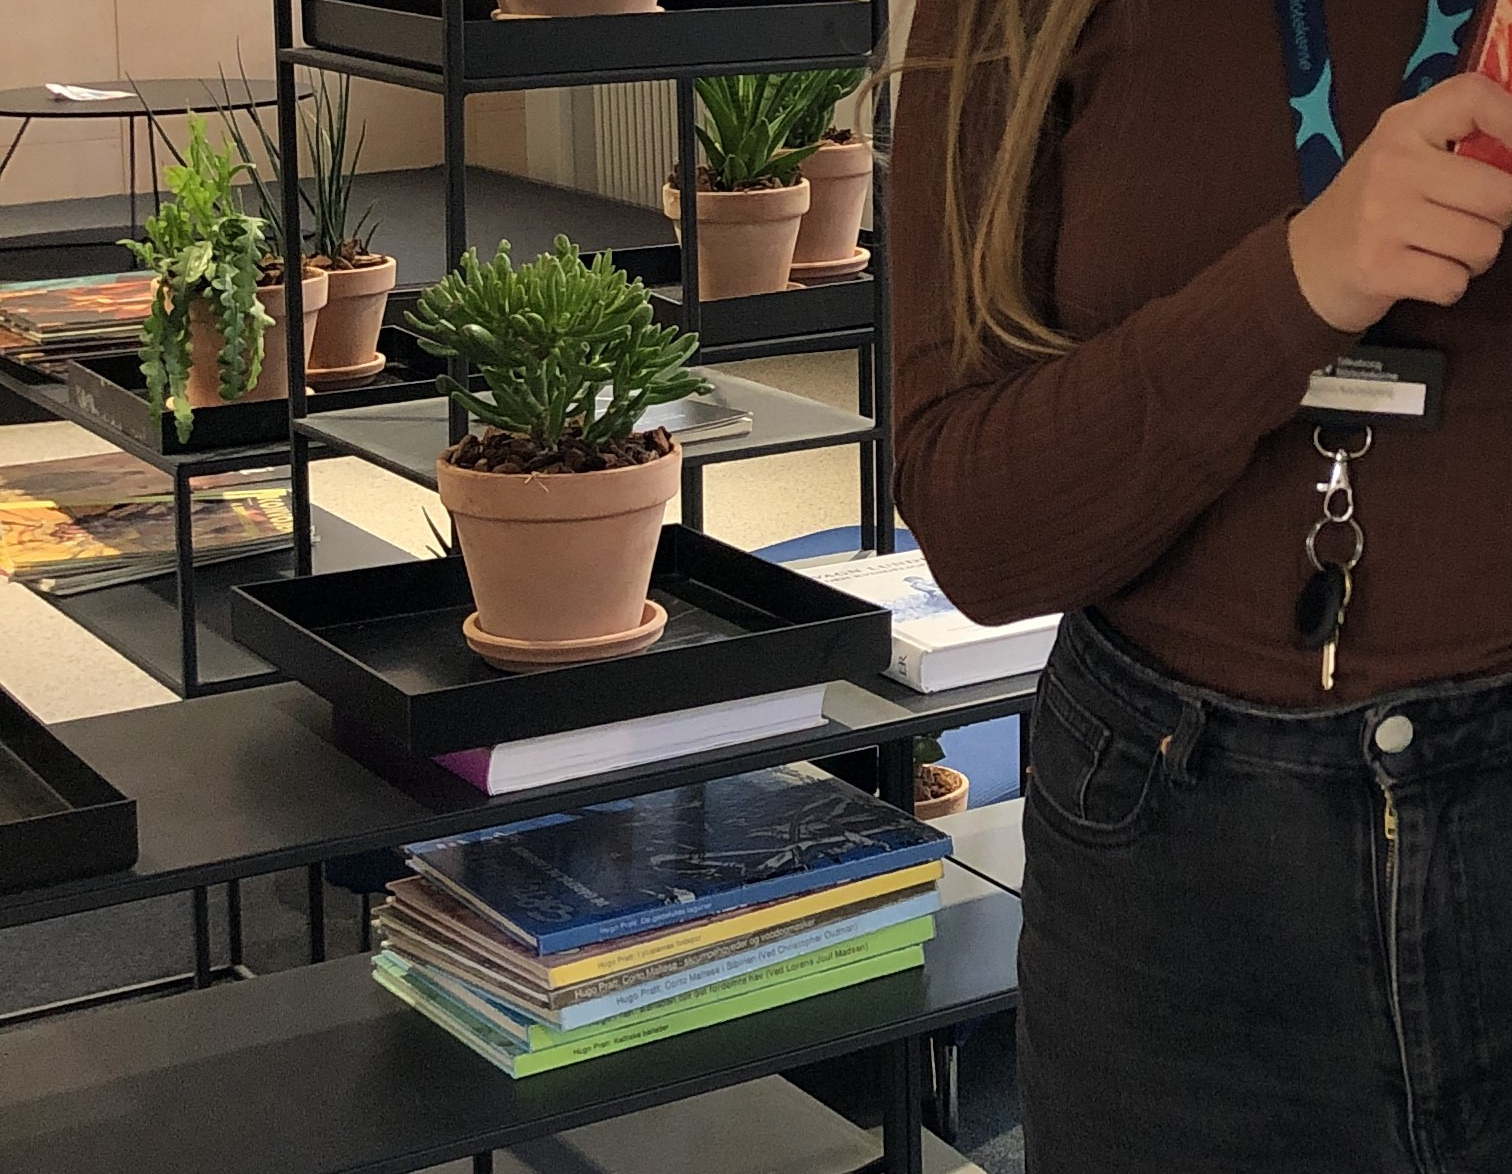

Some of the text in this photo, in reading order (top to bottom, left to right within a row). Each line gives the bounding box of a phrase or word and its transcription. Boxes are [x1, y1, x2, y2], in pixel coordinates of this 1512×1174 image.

[574, 985, 598, 1000] Hugo
[622, 970, 644, 985] Corto
[645, 960, 677, 978] Maltese
[749, 935, 760, 946] og
[616, 993, 638, 1005] Hugo
[664, 979, 687, 991] Corto
[689, 968, 720, 982] Maltese
[777, 935, 822, 955] Christopher
[835, 942, 868, 958] Madsen)
[573, 1045, 592, 1056] Hugo
